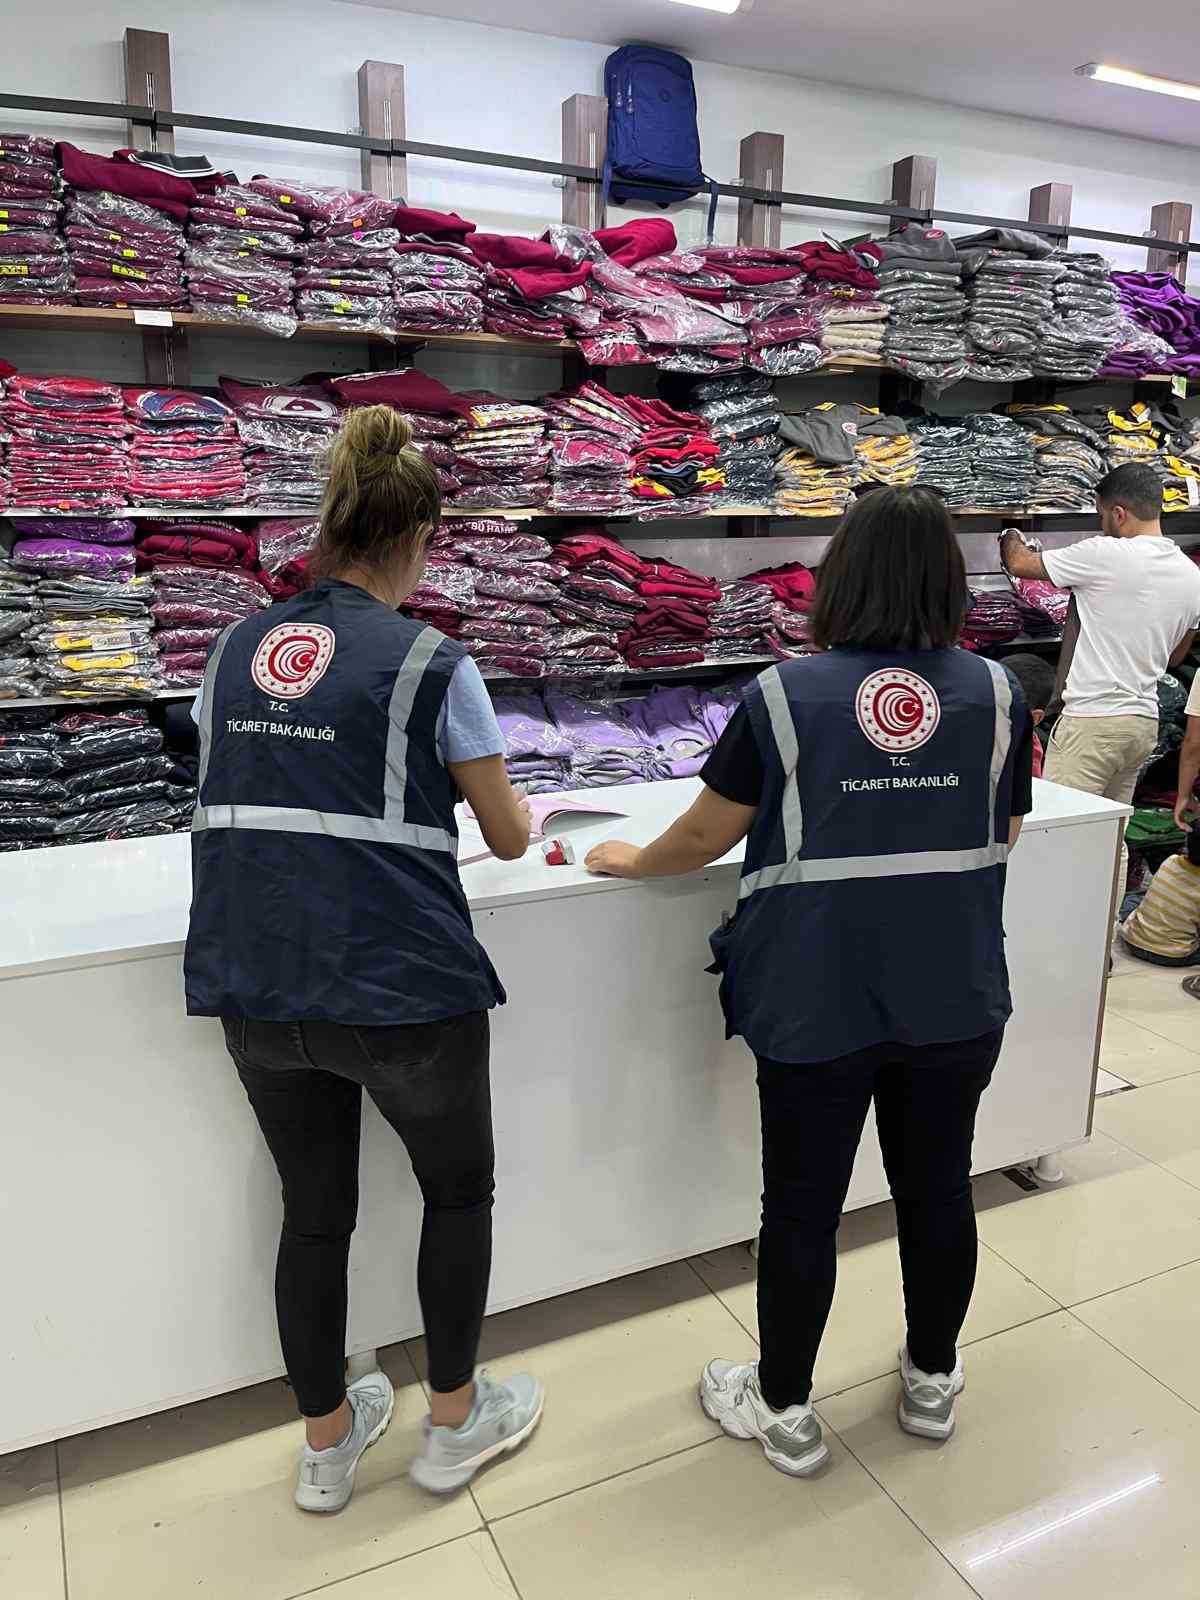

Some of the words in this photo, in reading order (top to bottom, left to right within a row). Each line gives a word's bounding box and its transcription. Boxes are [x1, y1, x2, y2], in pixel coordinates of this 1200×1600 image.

[269, 700, 289, 713] T.C.
[226, 718, 269, 733] TİCARET
[269, 722, 336, 742] BAKANLIĞI
[889, 756, 911, 767] T.C.
[839, 778, 891, 793] TİCARET
[892, 772, 960, 789] BAKANLIĞI
